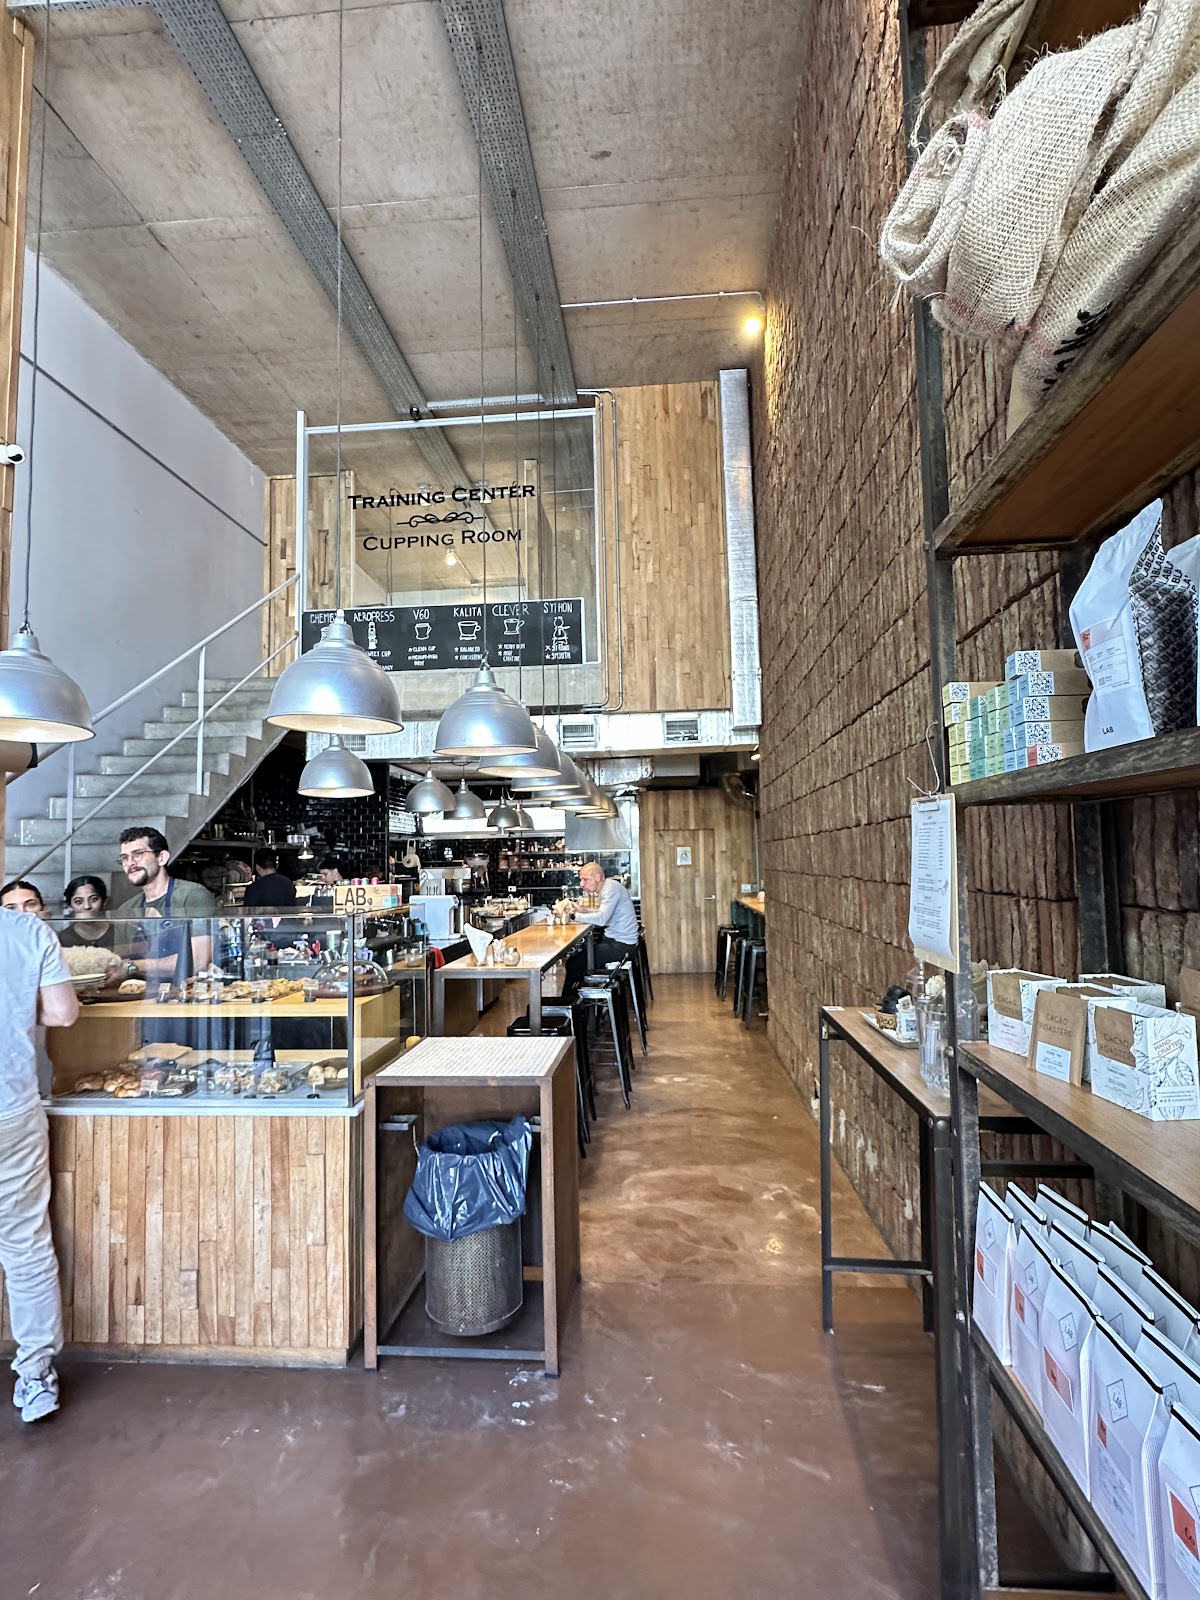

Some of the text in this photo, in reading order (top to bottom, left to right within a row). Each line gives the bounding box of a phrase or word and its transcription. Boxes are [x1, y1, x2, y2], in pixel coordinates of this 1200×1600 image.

[347, 485, 535, 510] TRAINING CENTER
[363, 529, 521, 551] CUPPING ROOM
[413, 608, 430, 620] V60
[453, 606, 482, 617] KALITA
[491, 603, 529, 616] CLEVER
[310, 612, 337, 624] CHEME
[353, 611, 396, 623] AEROPRESS
[1102, 726, 1114, 735] LAB
[334, 887, 367, 906] LAB
[1046, 1013, 1068, 1026] CACAO
[1039, 1023, 1072, 1038] ROASTERS
[1103, 1033, 1129, 1048] CACAO
[1157, 1039, 1183, 1057] CRAFTED
